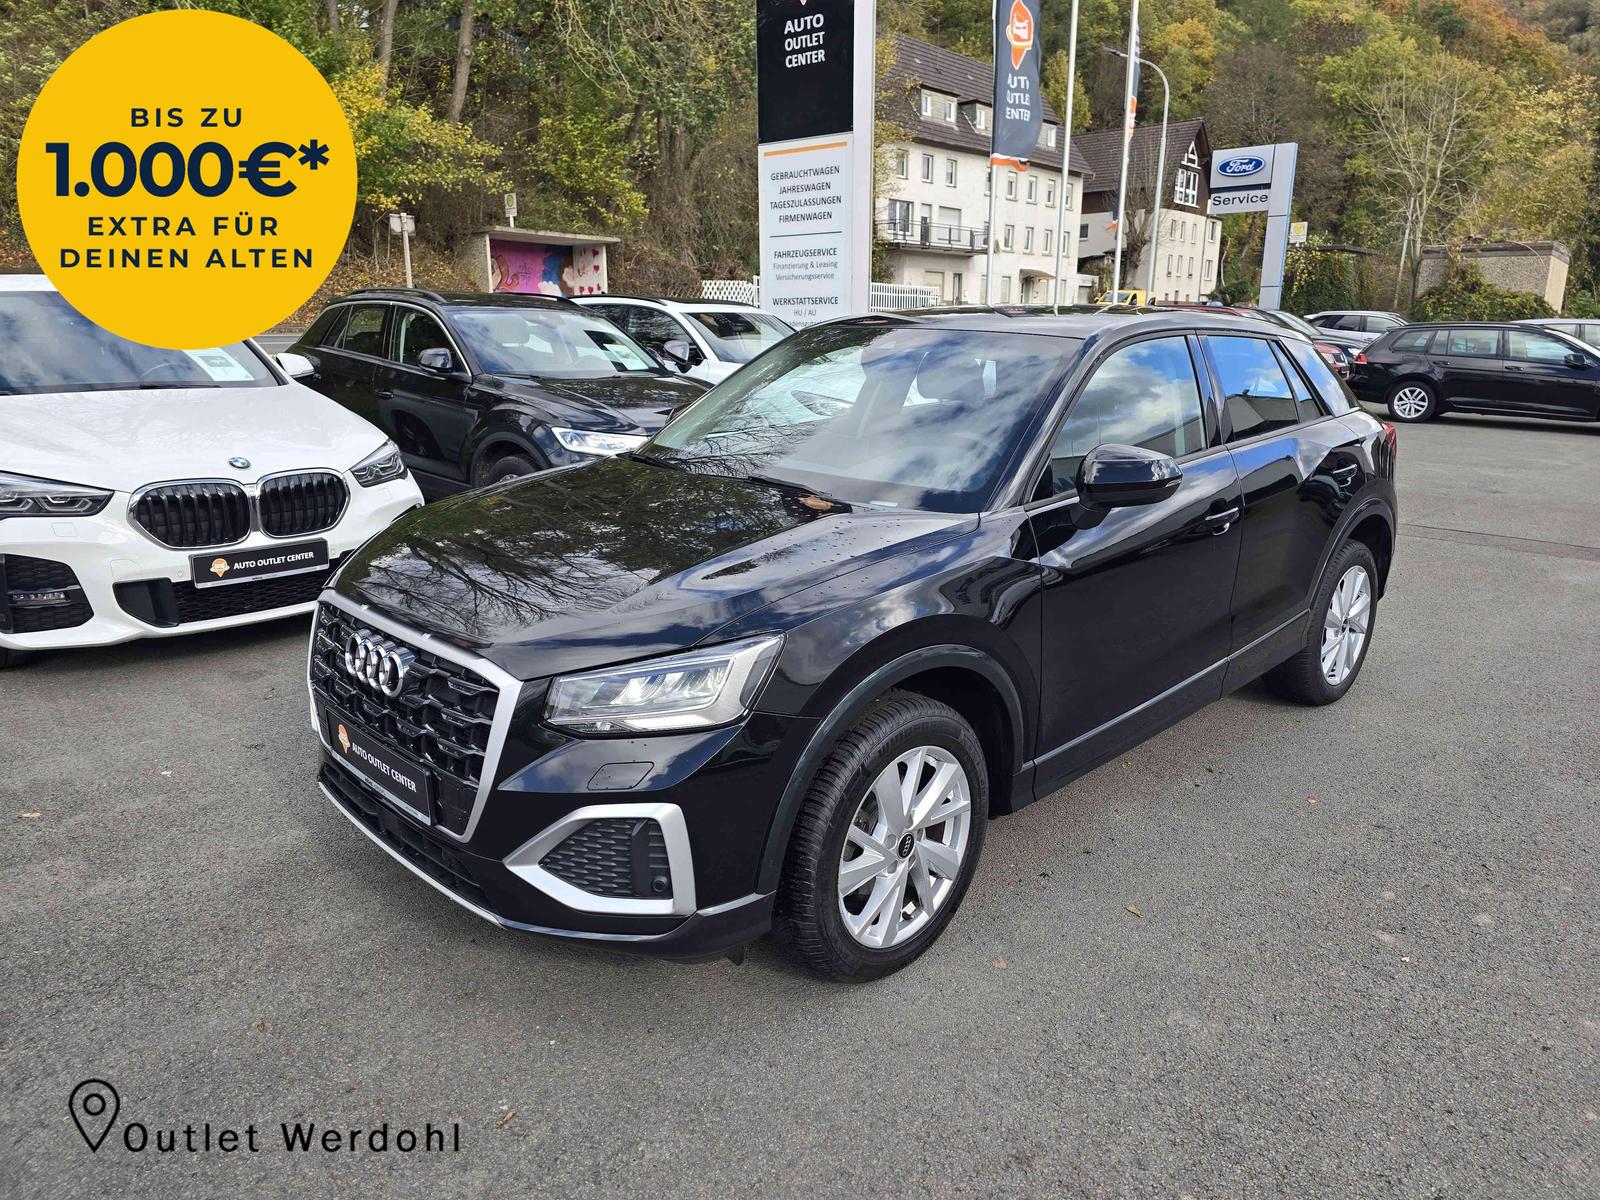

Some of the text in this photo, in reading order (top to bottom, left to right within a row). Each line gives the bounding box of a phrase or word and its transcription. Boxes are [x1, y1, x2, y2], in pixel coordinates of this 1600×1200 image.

[784, 13, 824, 35] AUTO
[785, 31, 826, 52] OUTLET
[785, 49, 826, 69] CENTER
[770, 165, 840, 181] GEBRAUCHTWAGEN
[1226, 158, 1255, 173] Ford
[779, 182, 831, 195] JAHRESWAGEN
[770, 195, 842, 210] TAGESZULASSUNGEN
[1212, 194, 1268, 206] Service
[778, 211, 832, 223] FIRMENWAGEN
[774, 247, 837, 259] FAHRZEUGSERVICE
[773, 262, 809, 271] Finanzierung
[815, 260, 838, 269] Leasing
[776, 272, 835, 282] Versicherungsservice
[772, 296, 839, 306] WERKSTATTSERVICE
[233, 551, 314, 570] AUTO OUTLET CENTER
[352, 742, 368, 761] AUTO
[367, 753, 390, 777] OUTLET
[390, 768, 417, 793] CENTER
